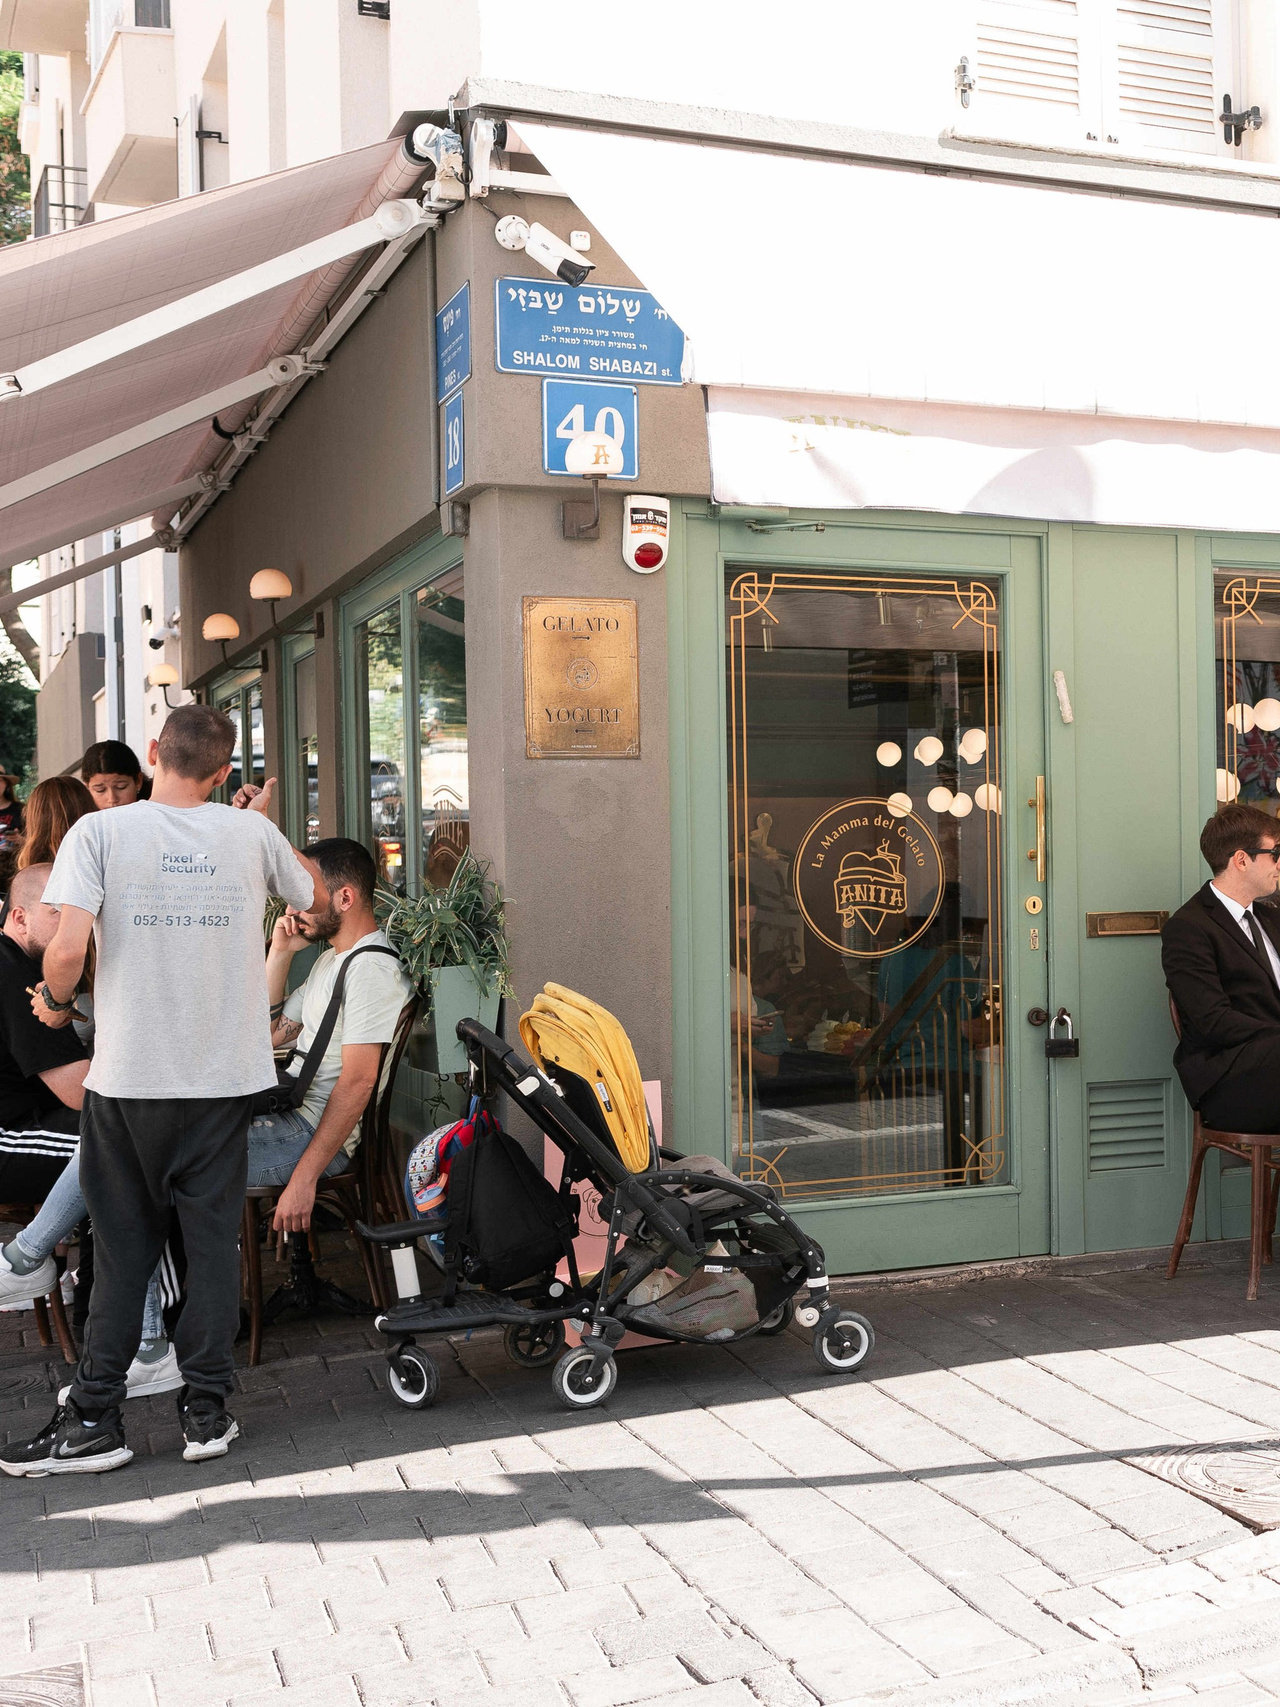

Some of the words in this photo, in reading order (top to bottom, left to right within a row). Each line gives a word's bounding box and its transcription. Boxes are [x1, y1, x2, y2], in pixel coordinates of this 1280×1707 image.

[513, 351, 580, 369] SHALOM
[589, 358, 657, 376] SHABAZI
[661, 367, 673, 378] st.
[556, 403, 625, 450] 40
[447, 416, 460, 470] 18
[592, 444, 609, 465] A
[543, 616, 619, 632] GELATO
[544, 707, 623, 724] YOGURT
[811, 854, 825, 869] La
[820, 817, 869, 850] Mamma
[874, 815, 895, 830] del
[897, 825, 925, 867] Gelato
[163, 853, 193, 863] Pixel
[161, 863, 217, 876] Security
[840, 884, 904, 907] ANITA
[133, 915, 230, 927] 052-513-4523
